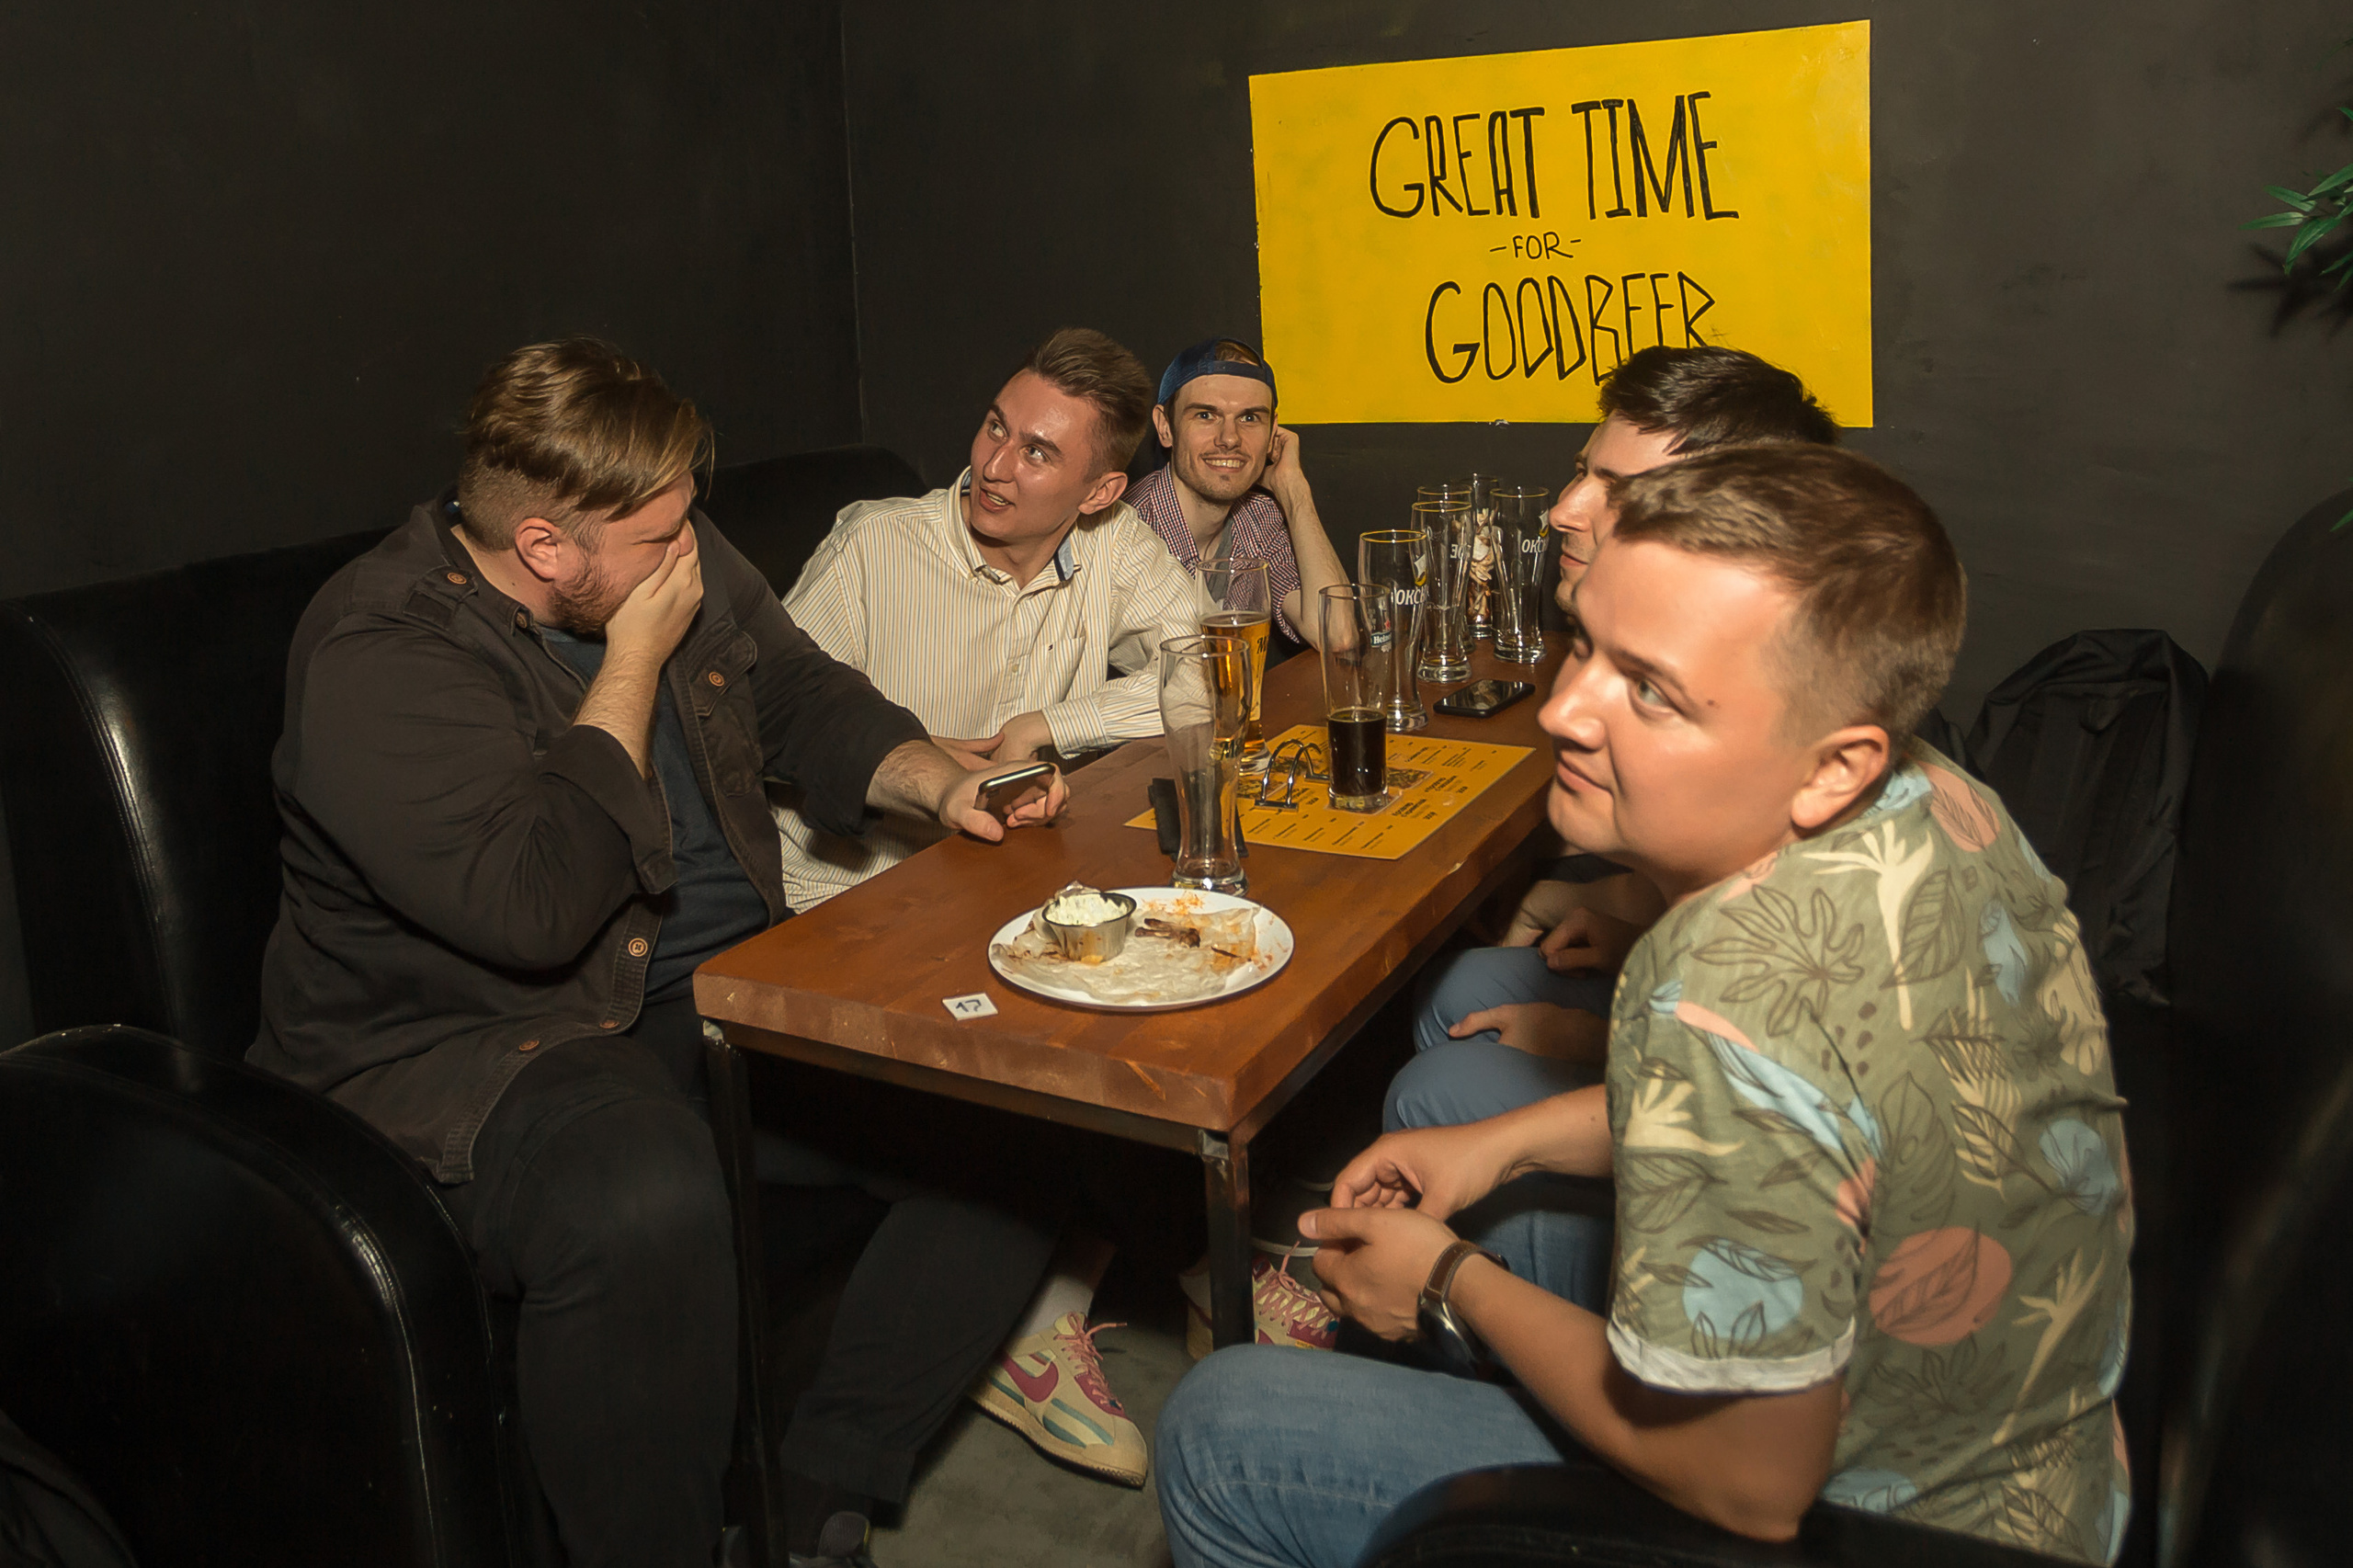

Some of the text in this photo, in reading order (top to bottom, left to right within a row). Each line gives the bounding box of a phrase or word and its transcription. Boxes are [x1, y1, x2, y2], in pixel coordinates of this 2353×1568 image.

[1370, 91, 1740, 221] GREAT TIME
[955, 999, 982, 1013] 17
